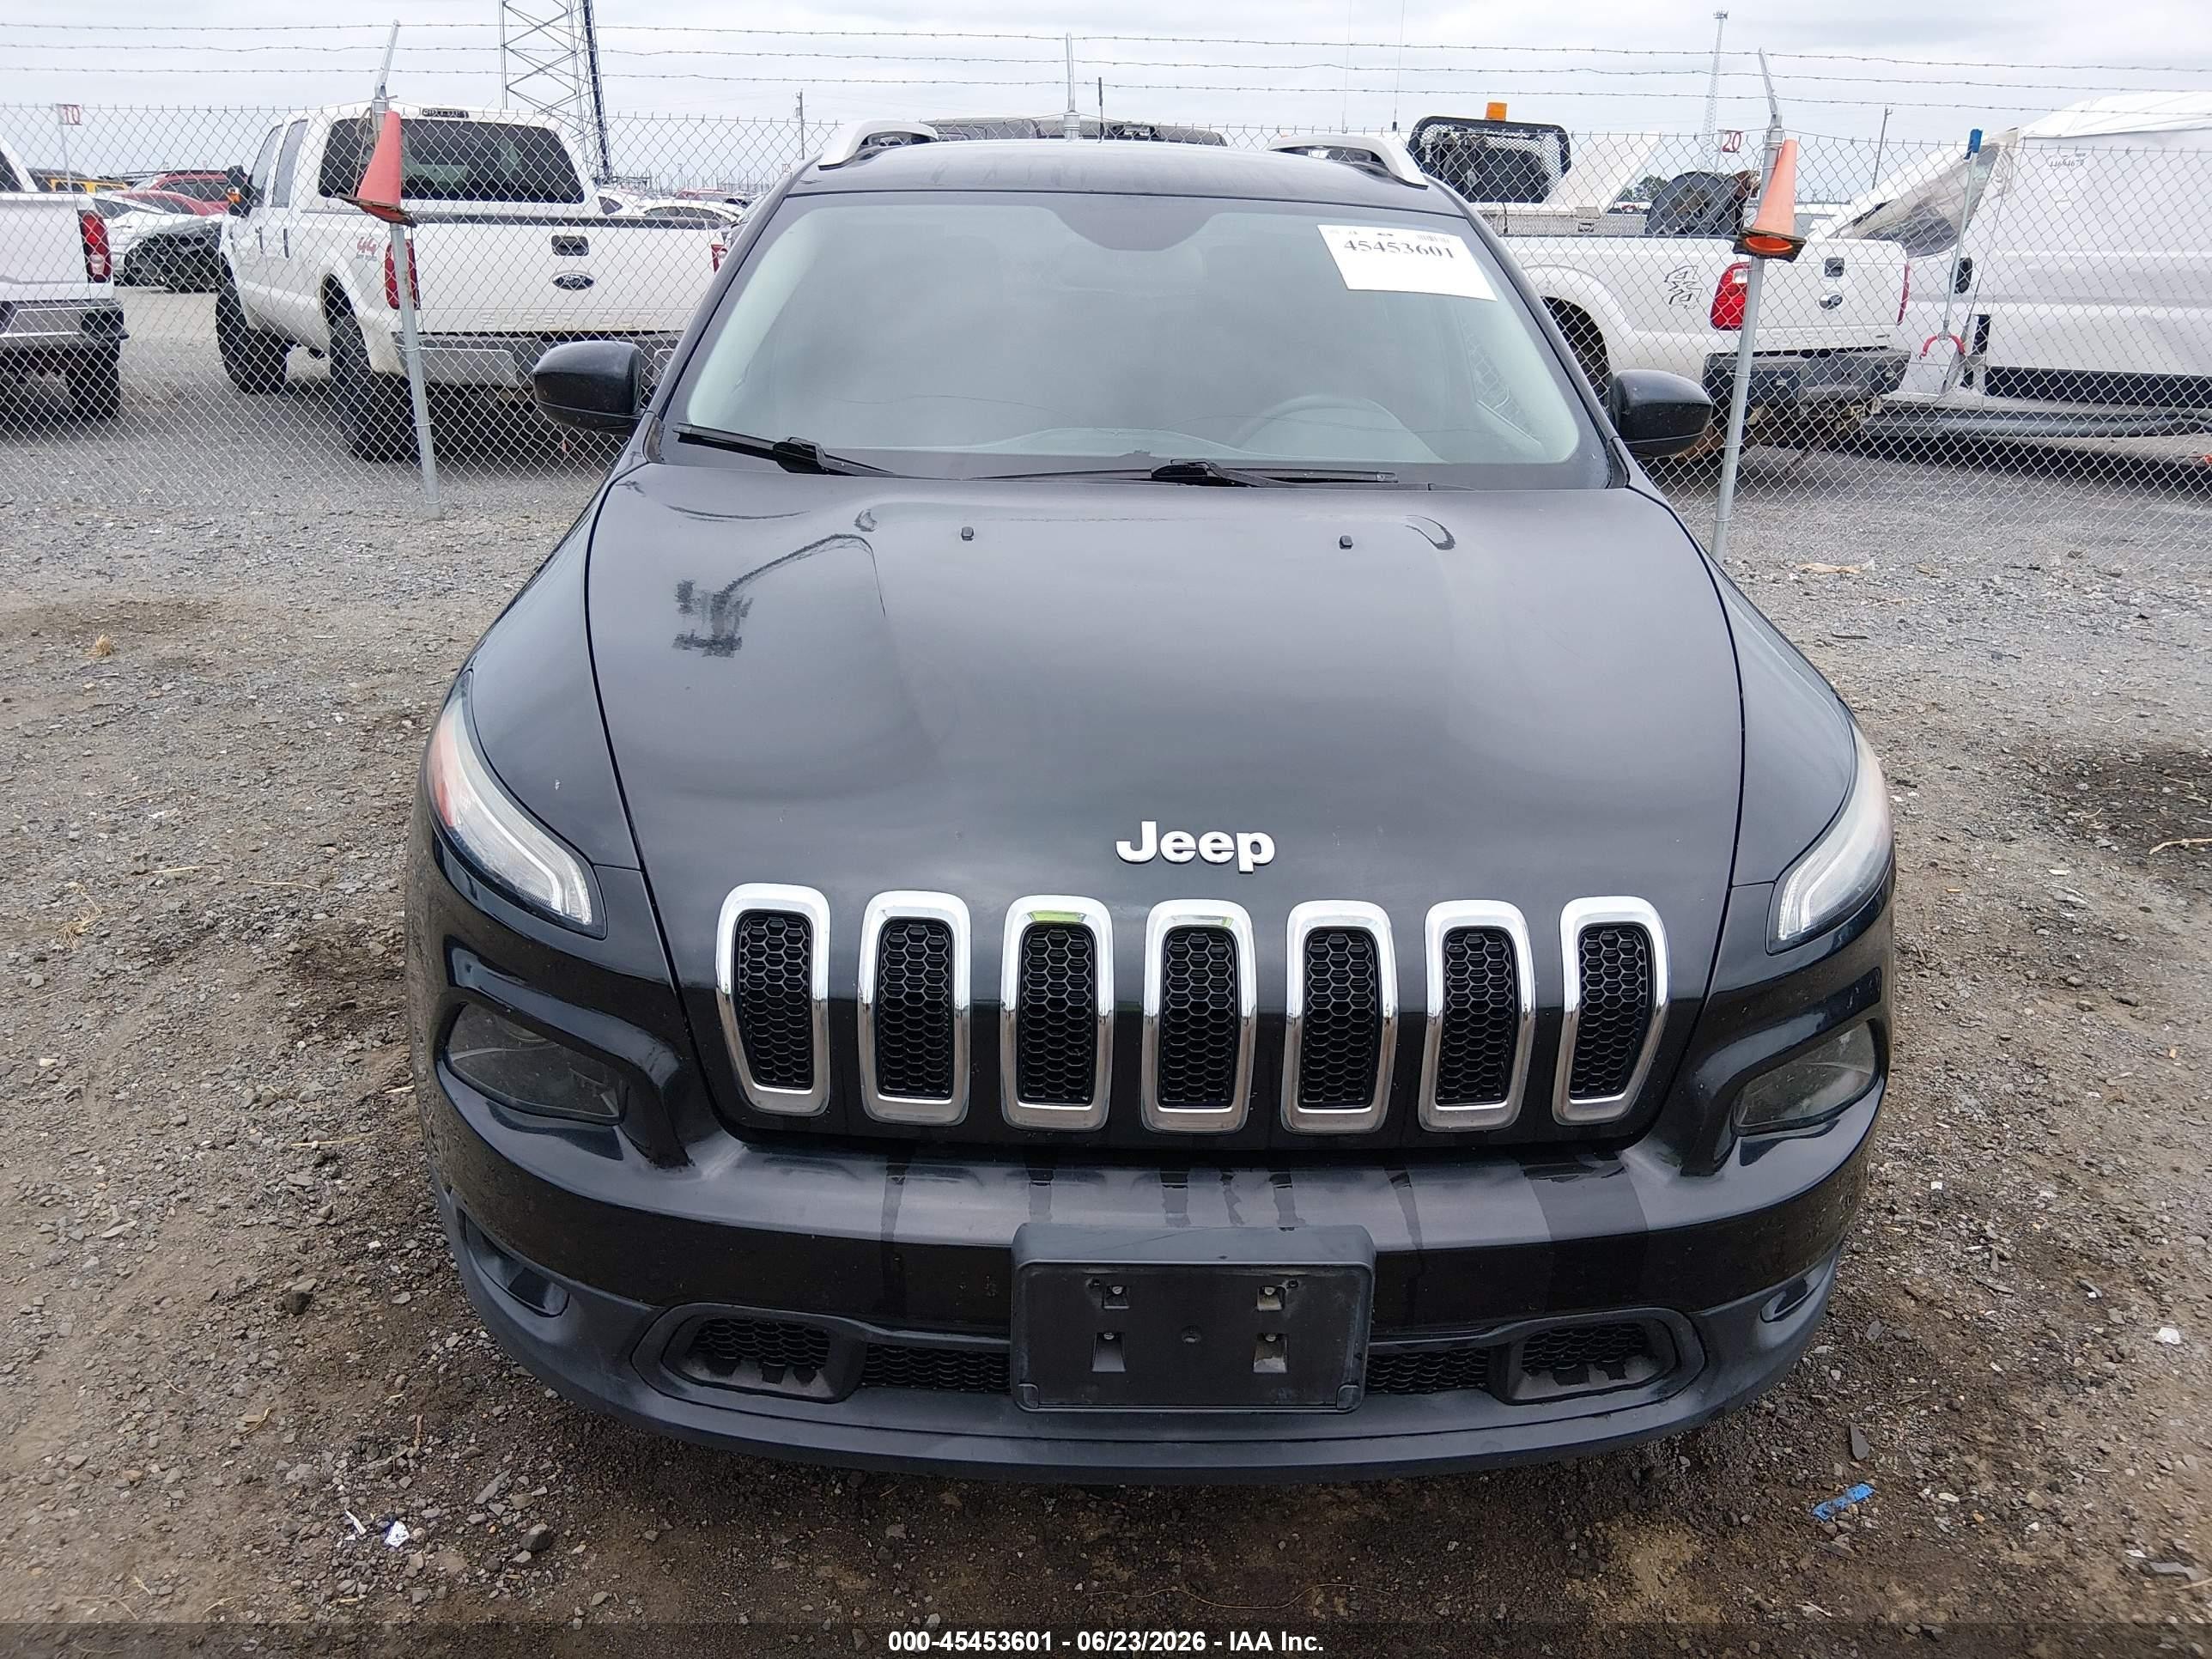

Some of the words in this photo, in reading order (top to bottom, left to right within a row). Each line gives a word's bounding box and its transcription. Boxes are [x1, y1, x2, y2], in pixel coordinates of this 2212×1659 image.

[1722, 131, 1741, 152] 20
[1344, 240, 1455, 258] 45453601
[1115, 821, 1276, 874] Jeep
